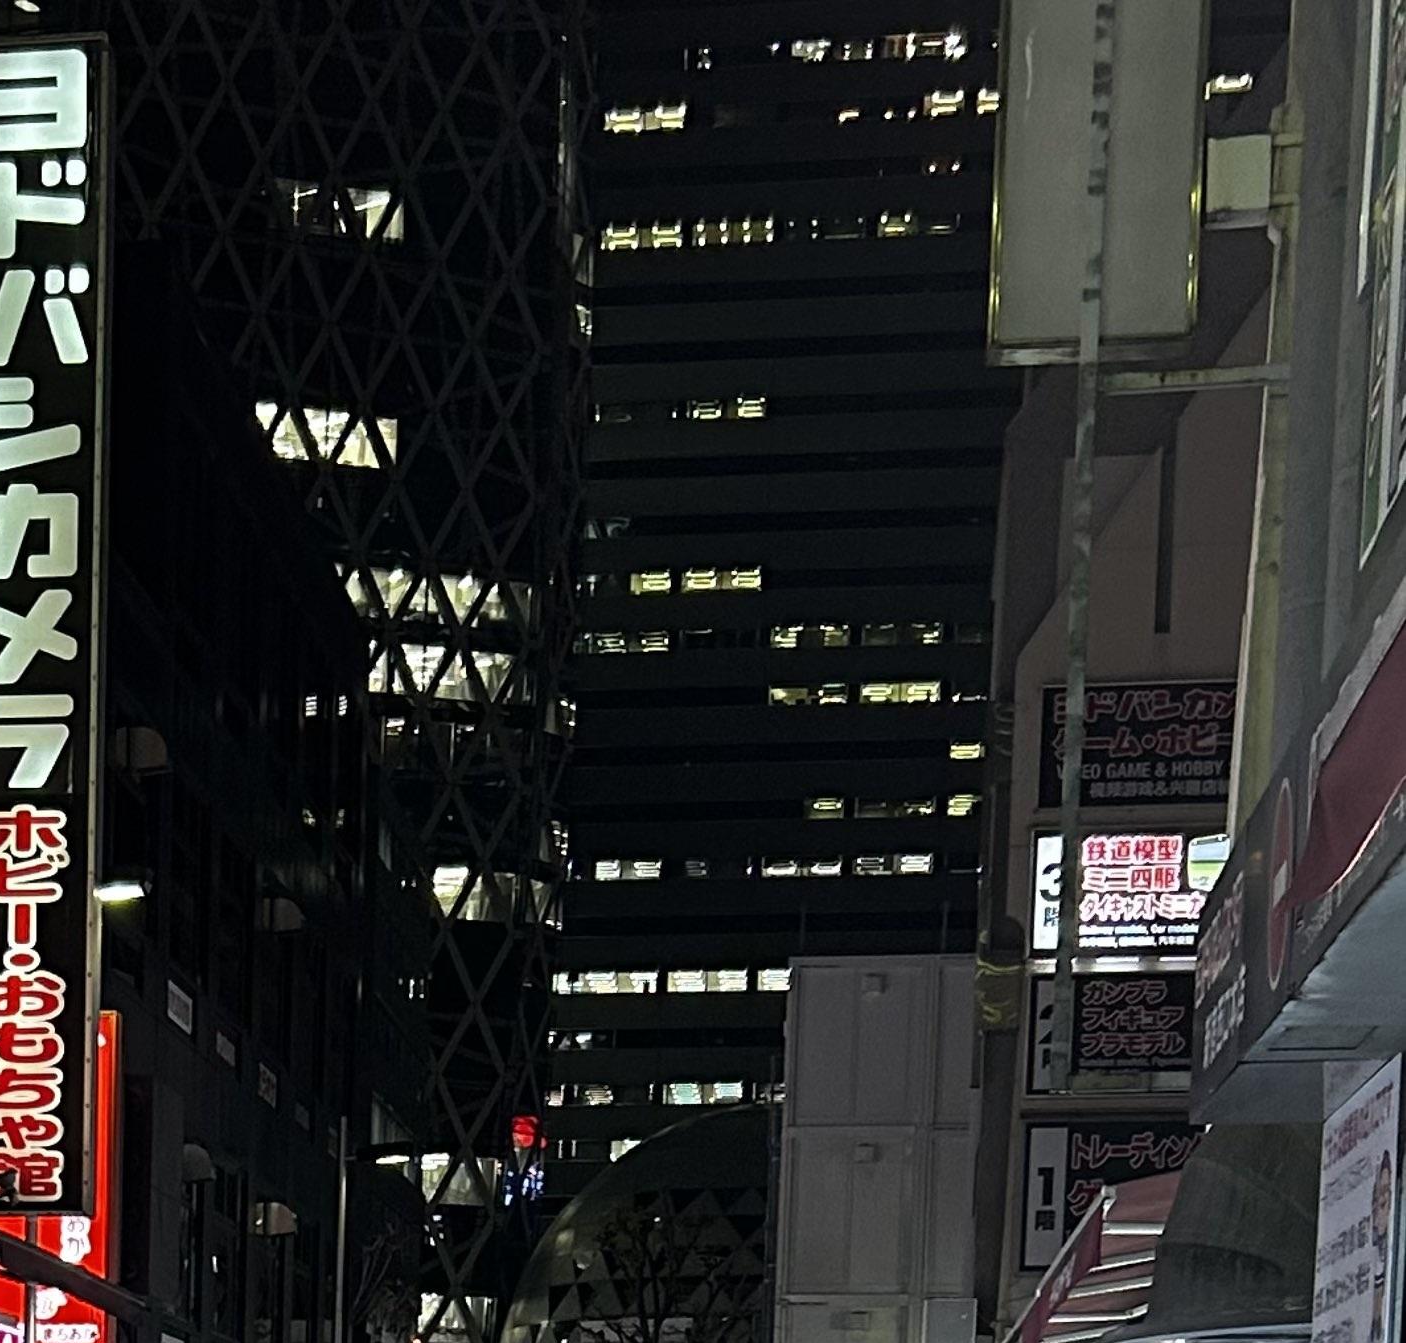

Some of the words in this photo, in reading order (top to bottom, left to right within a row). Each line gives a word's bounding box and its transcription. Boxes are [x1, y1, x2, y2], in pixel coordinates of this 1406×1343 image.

[1106, 762, 1151, 779] GAME
[1154, 763, 1168, 778] &
[1171, 759, 1224, 777] HOBBY
[1085, 837, 1181, 863] 鉄道模型
[1083, 866, 1178, 891] ミニ四駆
[1081, 980, 1168, 1005] ガンプラ
[1082, 1006, 1185, 1031] フィギュア
[1081, 1032, 1186, 1057] プラモデル
